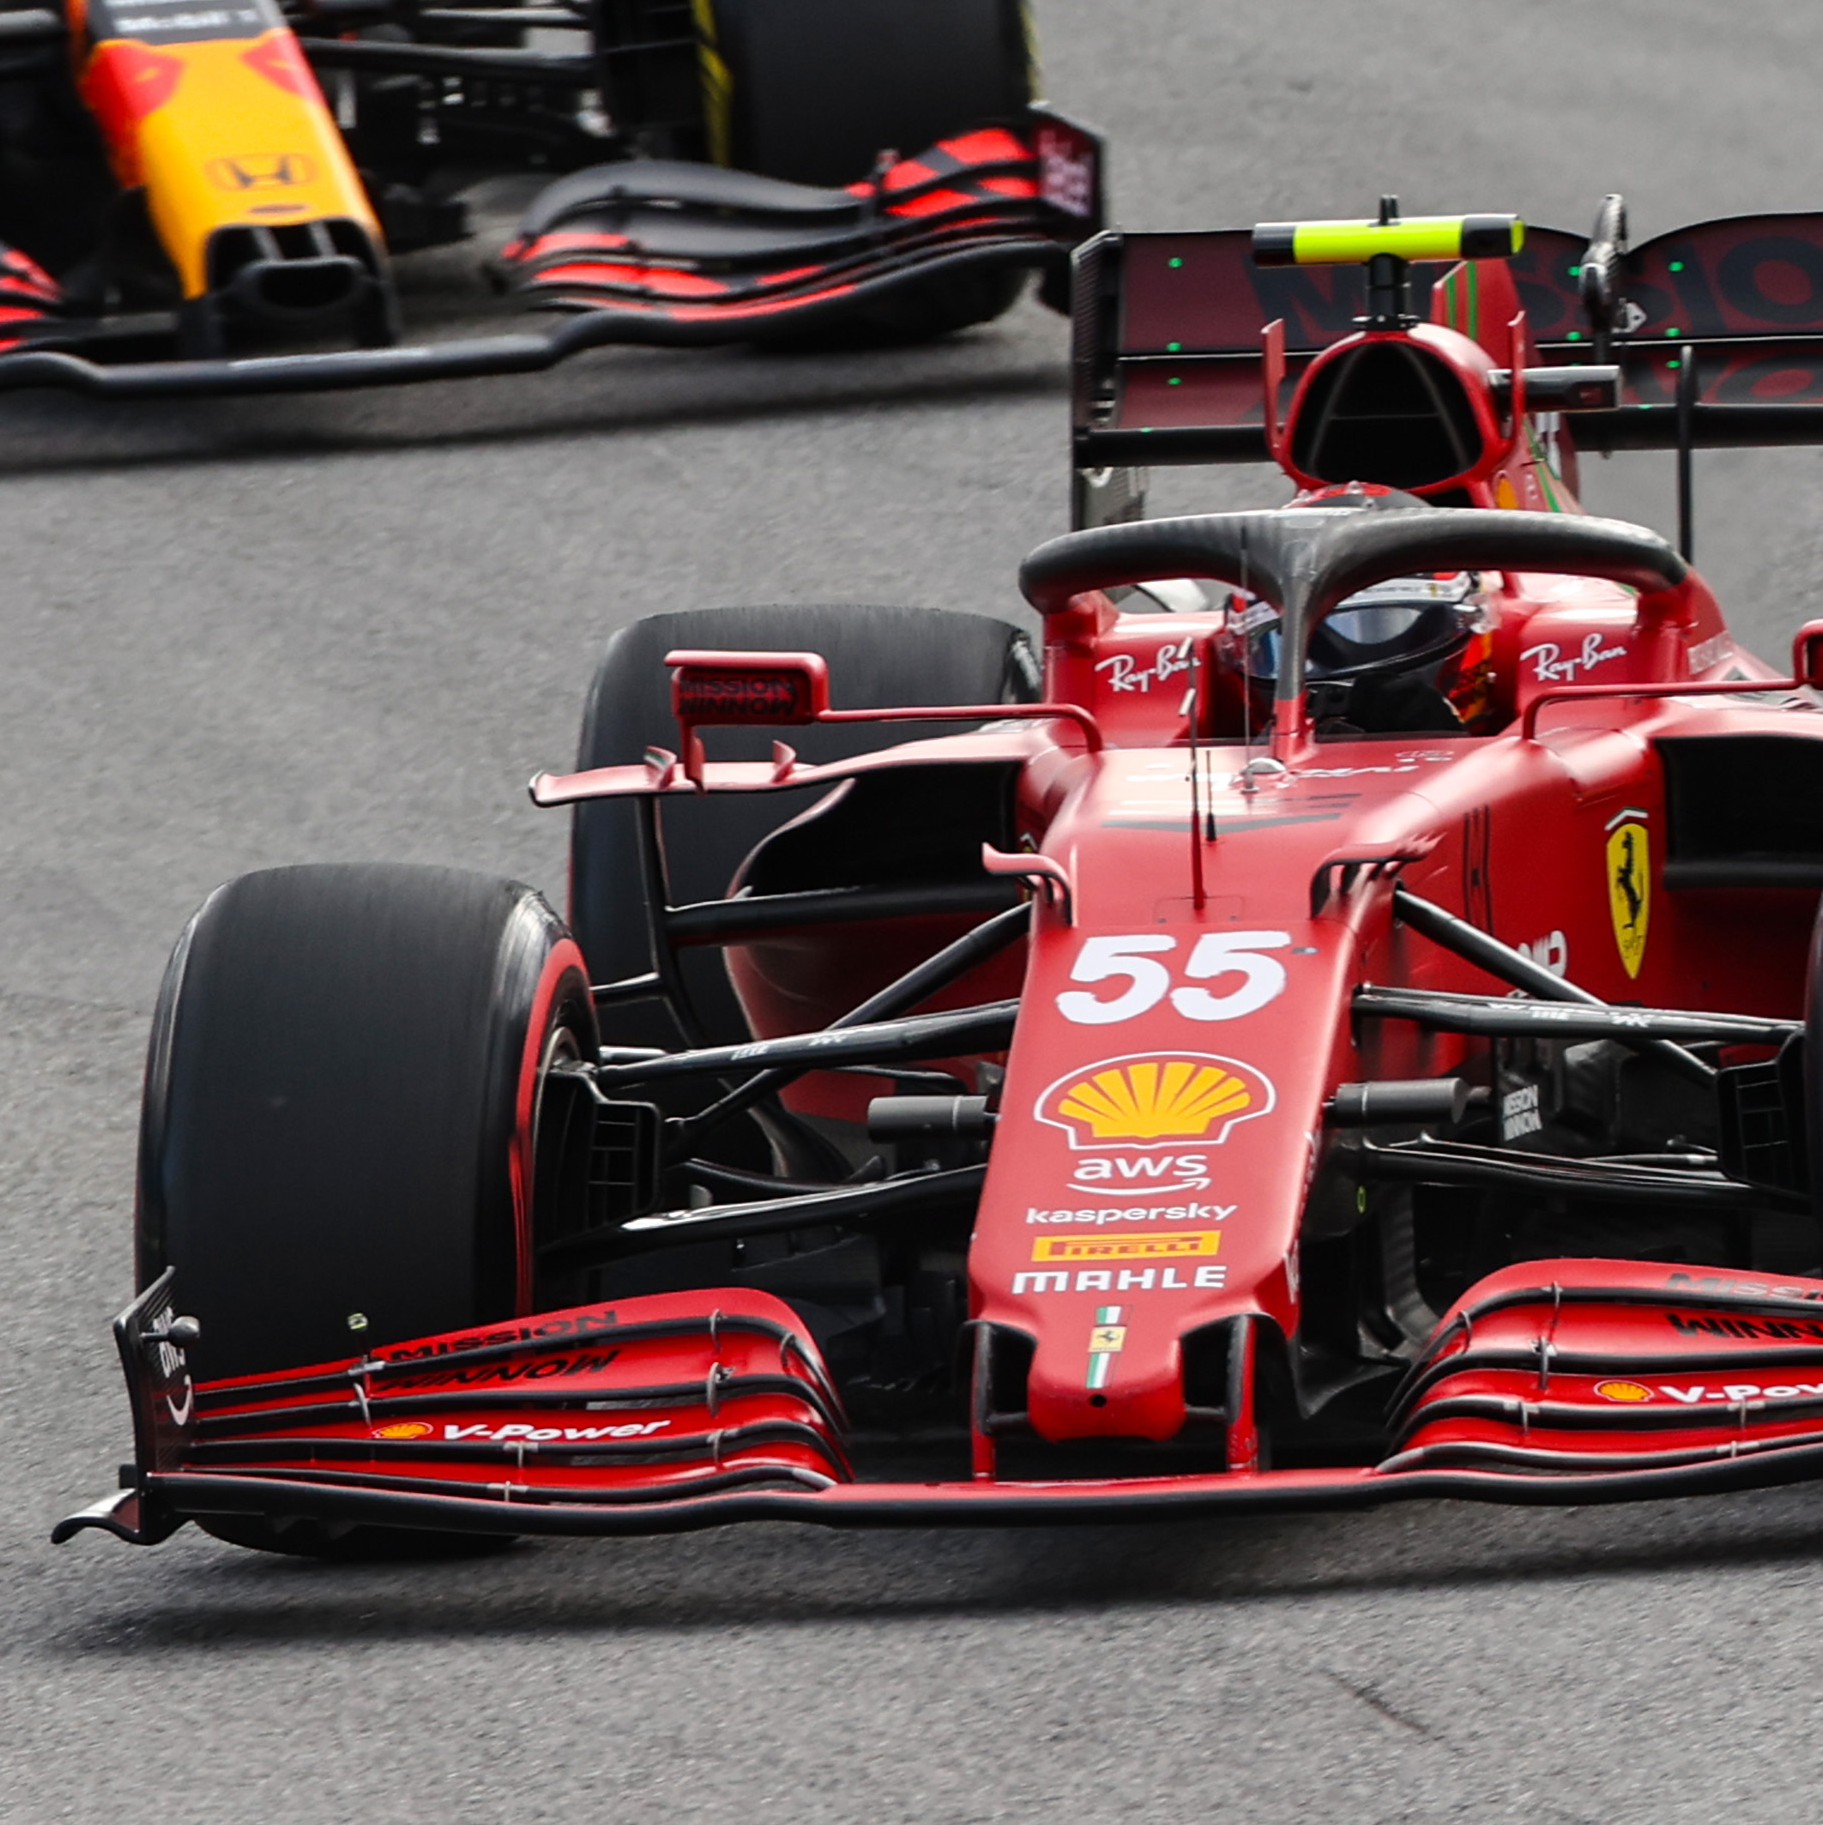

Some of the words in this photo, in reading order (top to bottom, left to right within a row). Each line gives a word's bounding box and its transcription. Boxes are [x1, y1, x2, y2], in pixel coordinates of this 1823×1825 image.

[1093, 643, 1202, 693] Ray-Ban
[1519, 632, 1628, 682] Ray-Ban
[1054, 929, 1293, 1026] 55
[1072, 1154, 1209, 1181] aws
[1025, 1201, 1239, 1226] kaspersky
[1047, 1235, 1205, 1257] PIRELLI
[1011, 1264, 1228, 1296] MAHLE
[389, 1309, 619, 1362] MISSION
[443, 1419, 672, 1442] V-Power
